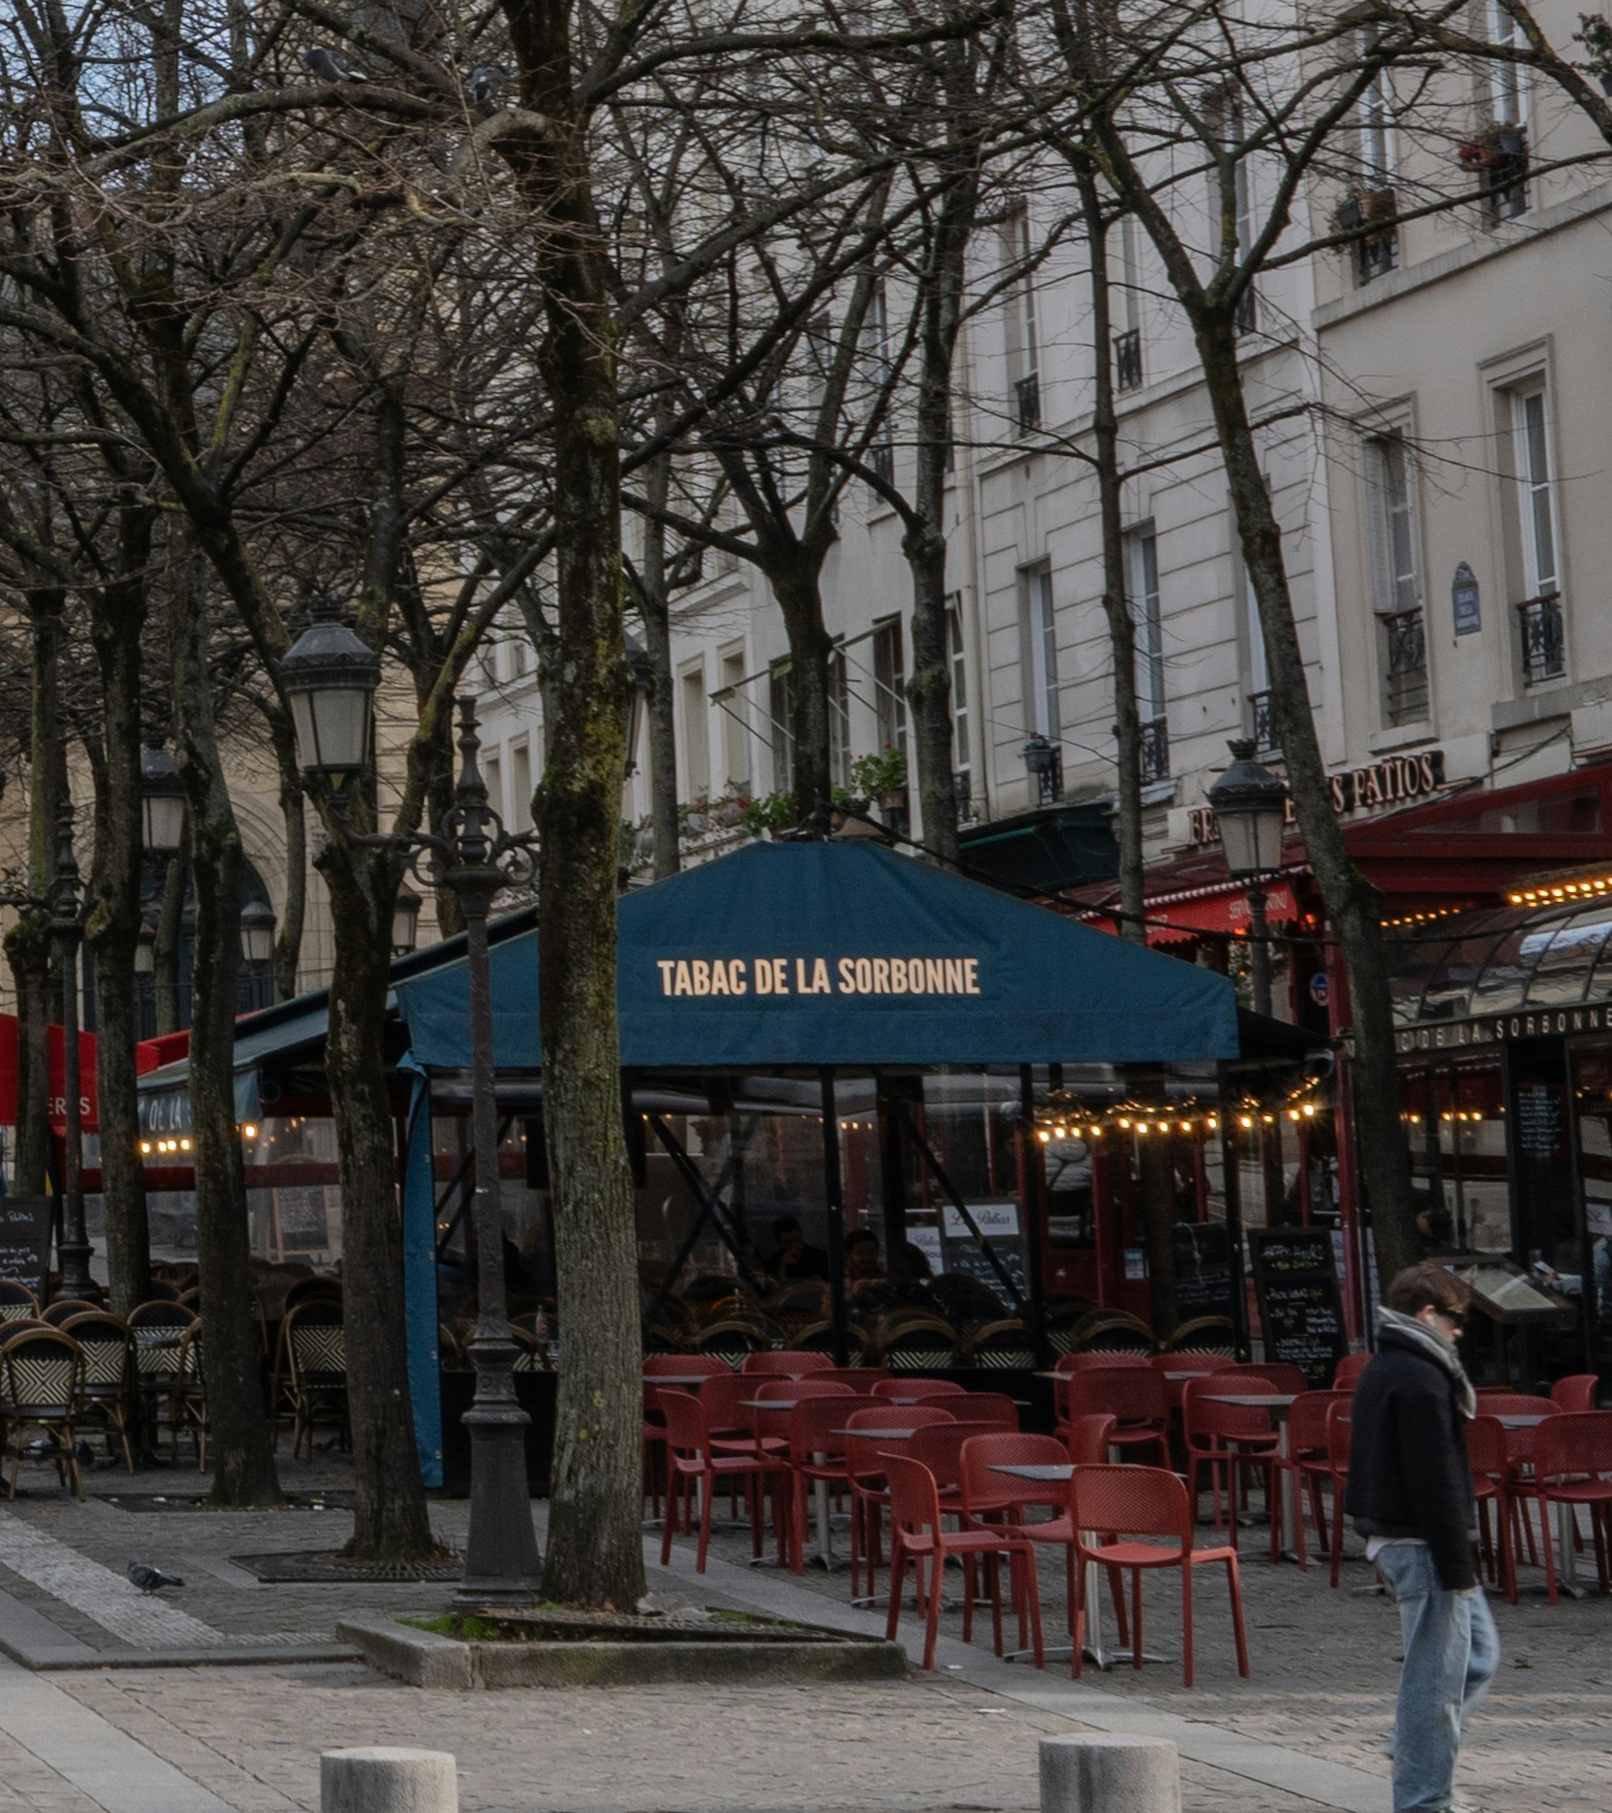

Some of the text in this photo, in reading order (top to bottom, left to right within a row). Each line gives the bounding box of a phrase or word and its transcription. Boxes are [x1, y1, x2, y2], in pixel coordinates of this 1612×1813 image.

[1352, 753, 1434, 808] PATIOS
[657, 958, 980, 996] TABAC DE LA SORBONNE
[1458, 1023, 1480, 1045] LA
[1496, 1008, 1612, 1039] SORBONNE
